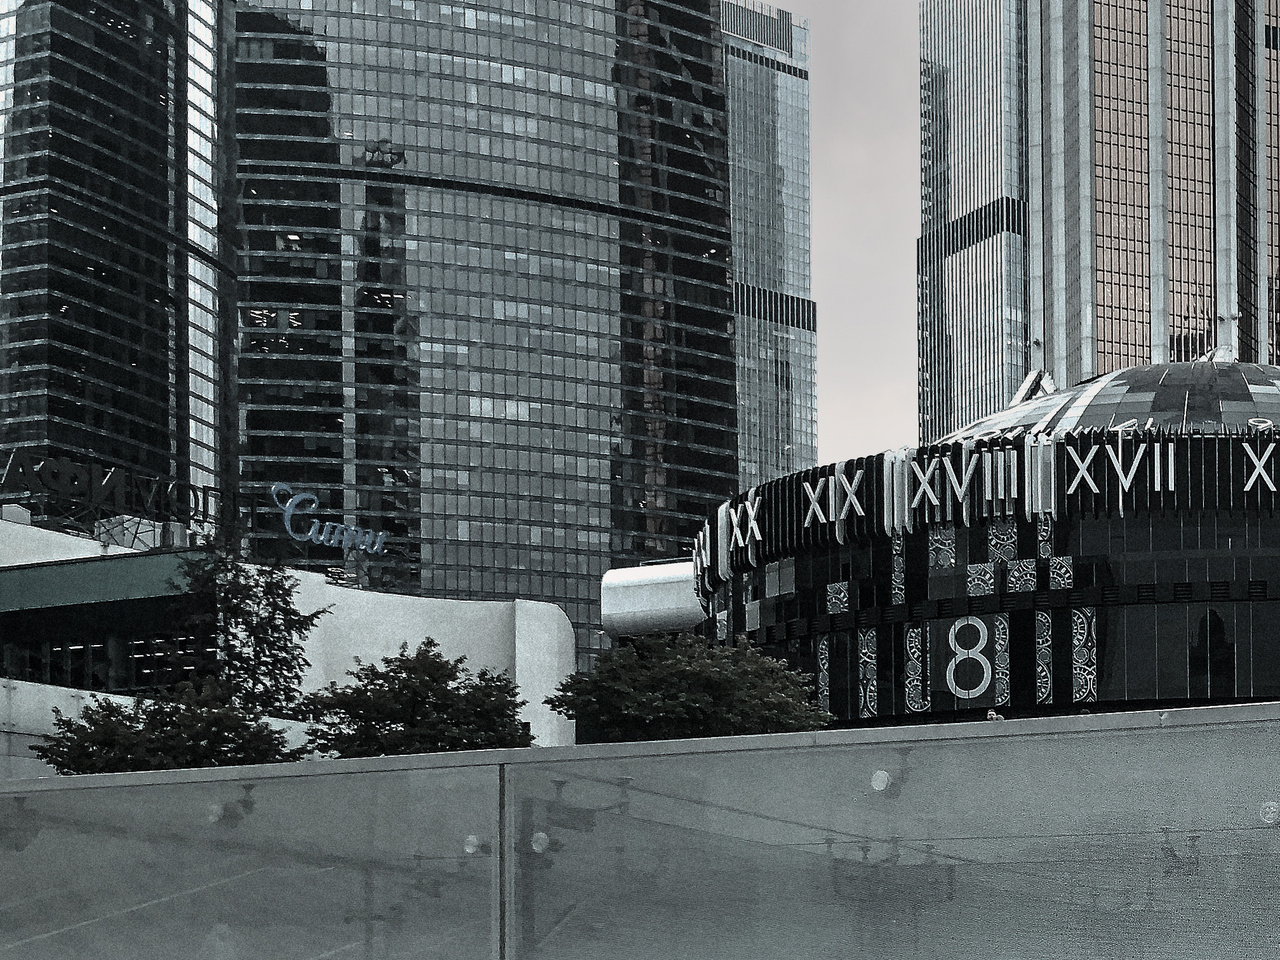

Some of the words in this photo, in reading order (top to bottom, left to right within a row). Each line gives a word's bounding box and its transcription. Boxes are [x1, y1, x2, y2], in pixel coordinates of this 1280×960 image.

[729, 496, 762, 551] XX
[804, 469, 865, 527] XIX
[911, 453, 1018, 508] XVIII
[1066, 442, 1175, 495] XVII
[946, 616, 992, 699] 8
